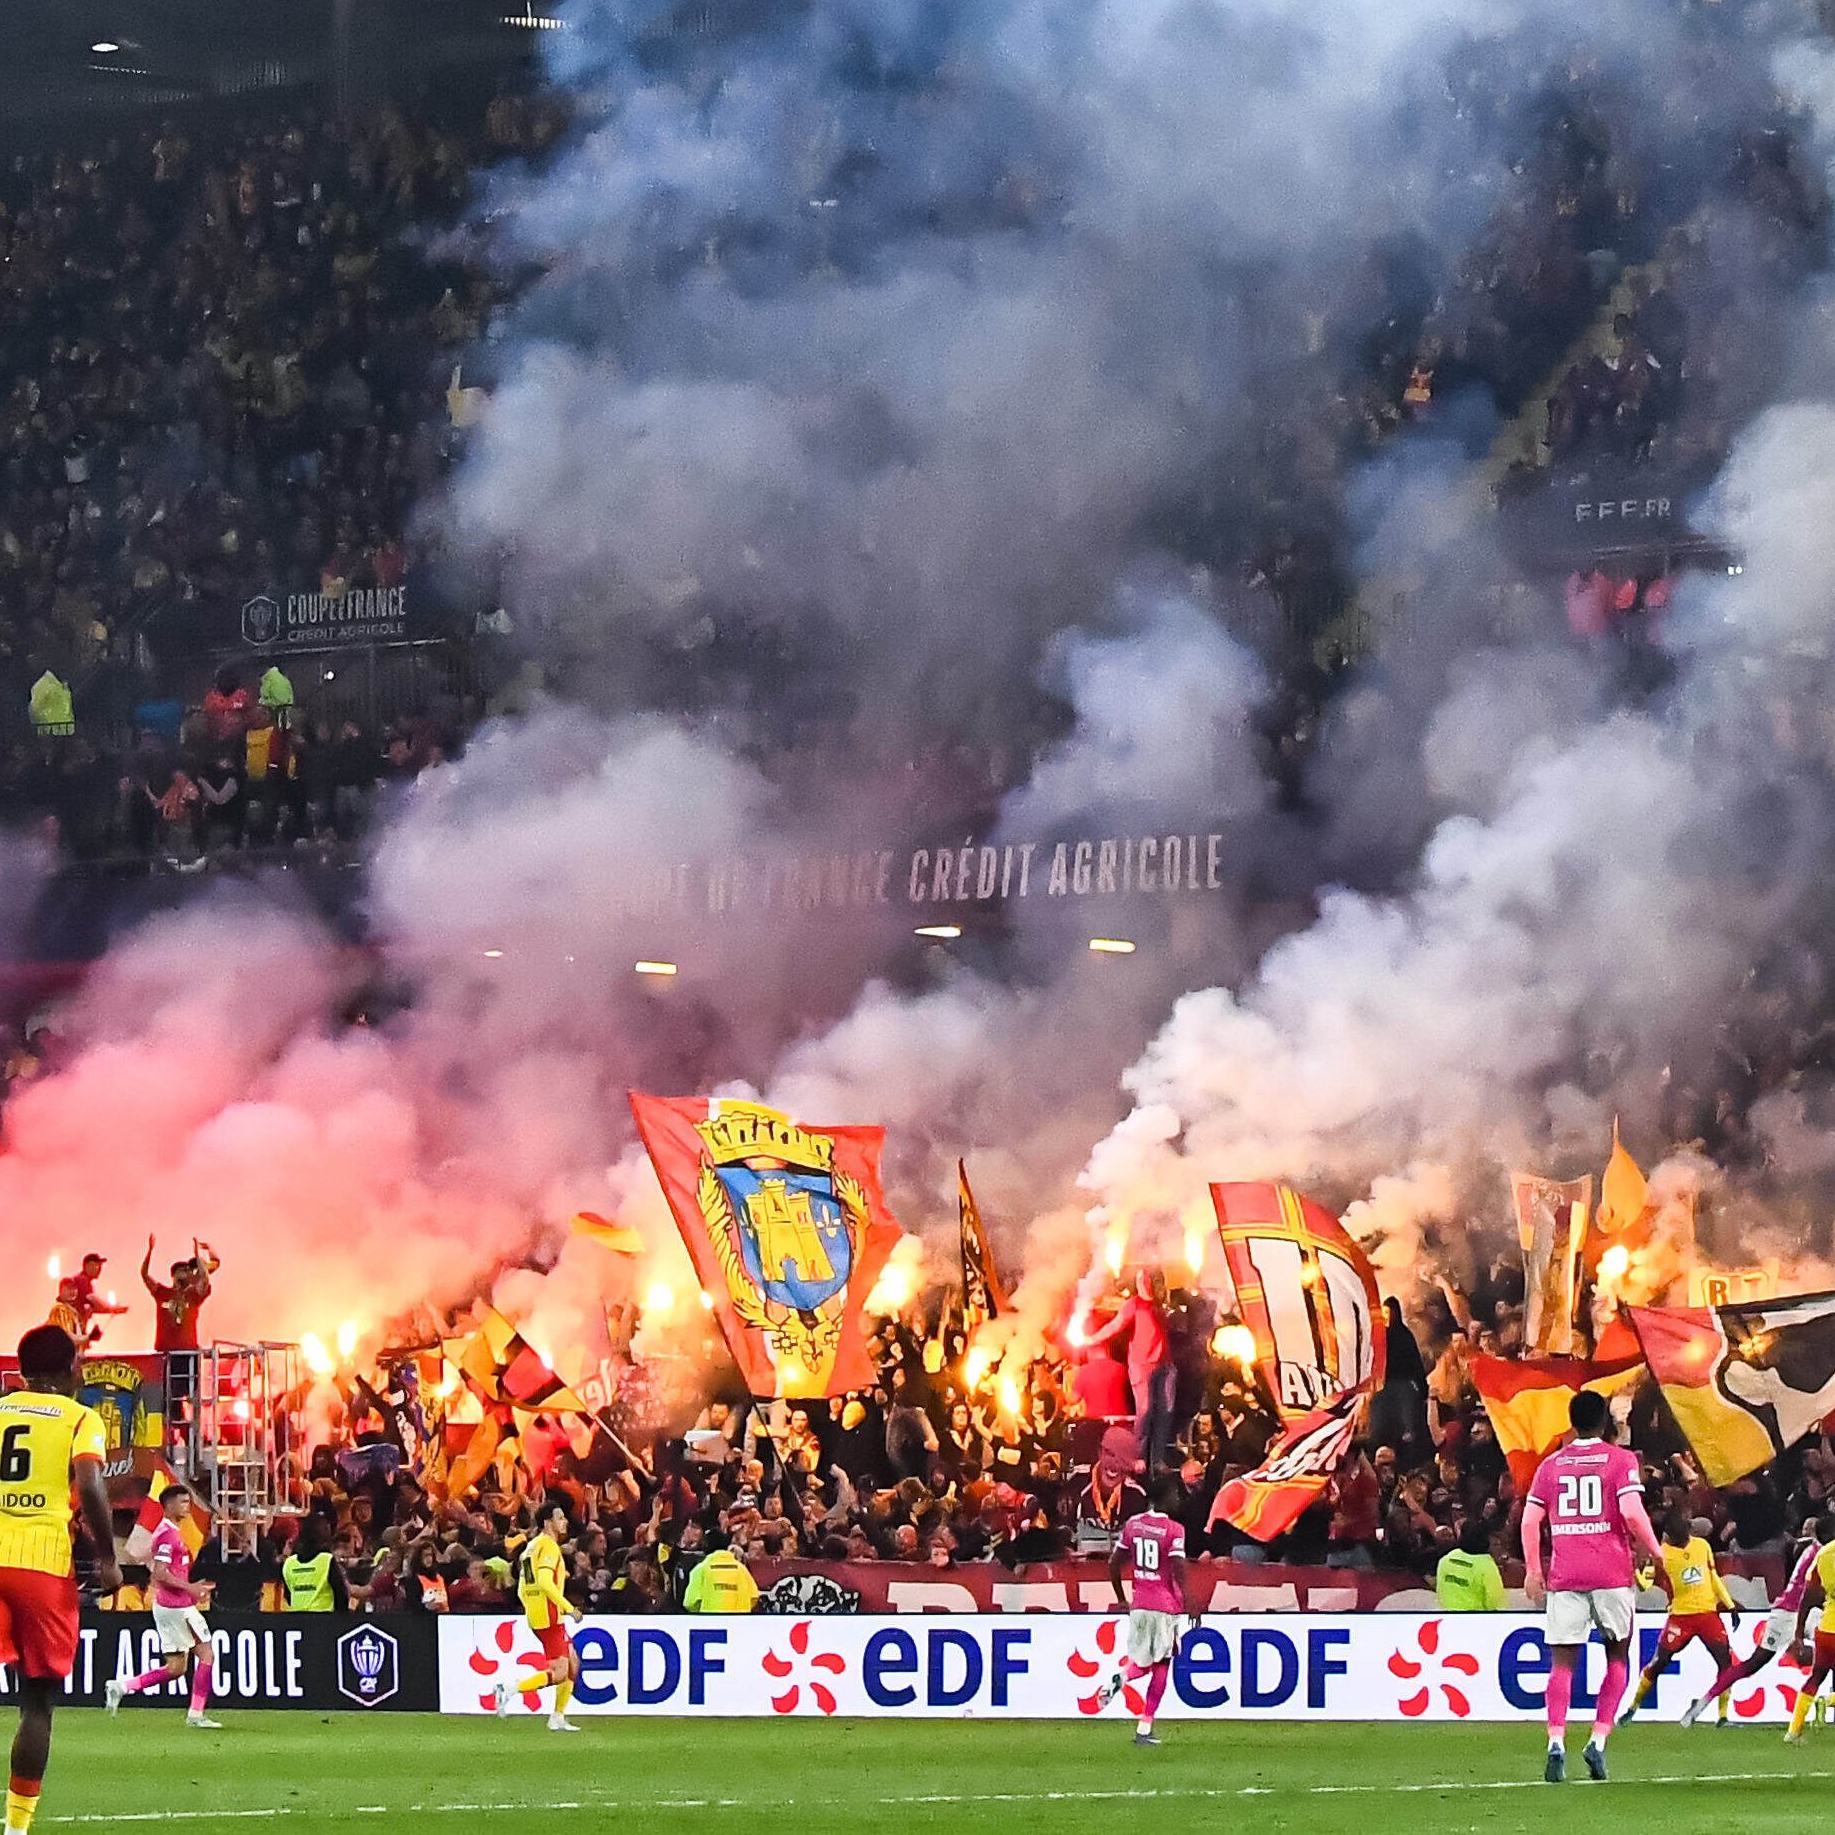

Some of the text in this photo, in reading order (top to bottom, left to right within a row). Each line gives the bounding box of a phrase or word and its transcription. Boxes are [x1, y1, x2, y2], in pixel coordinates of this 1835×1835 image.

[287, 592, 338, 624] COUPE
[347, 586, 406, 620] FRANCE
[908, 836, 1033, 902] CRÉDIT
[1049, 833, 1223, 897] AGRICOLE
[0, 1424, 32, 1482] 6
[1558, 1474, 1603, 1518] 20
[1551, 1521, 1612, 1536] EMERSONN
[1132, 1536, 1159, 1570] 18
[115, 1628, 304, 1698] AGCOLE
